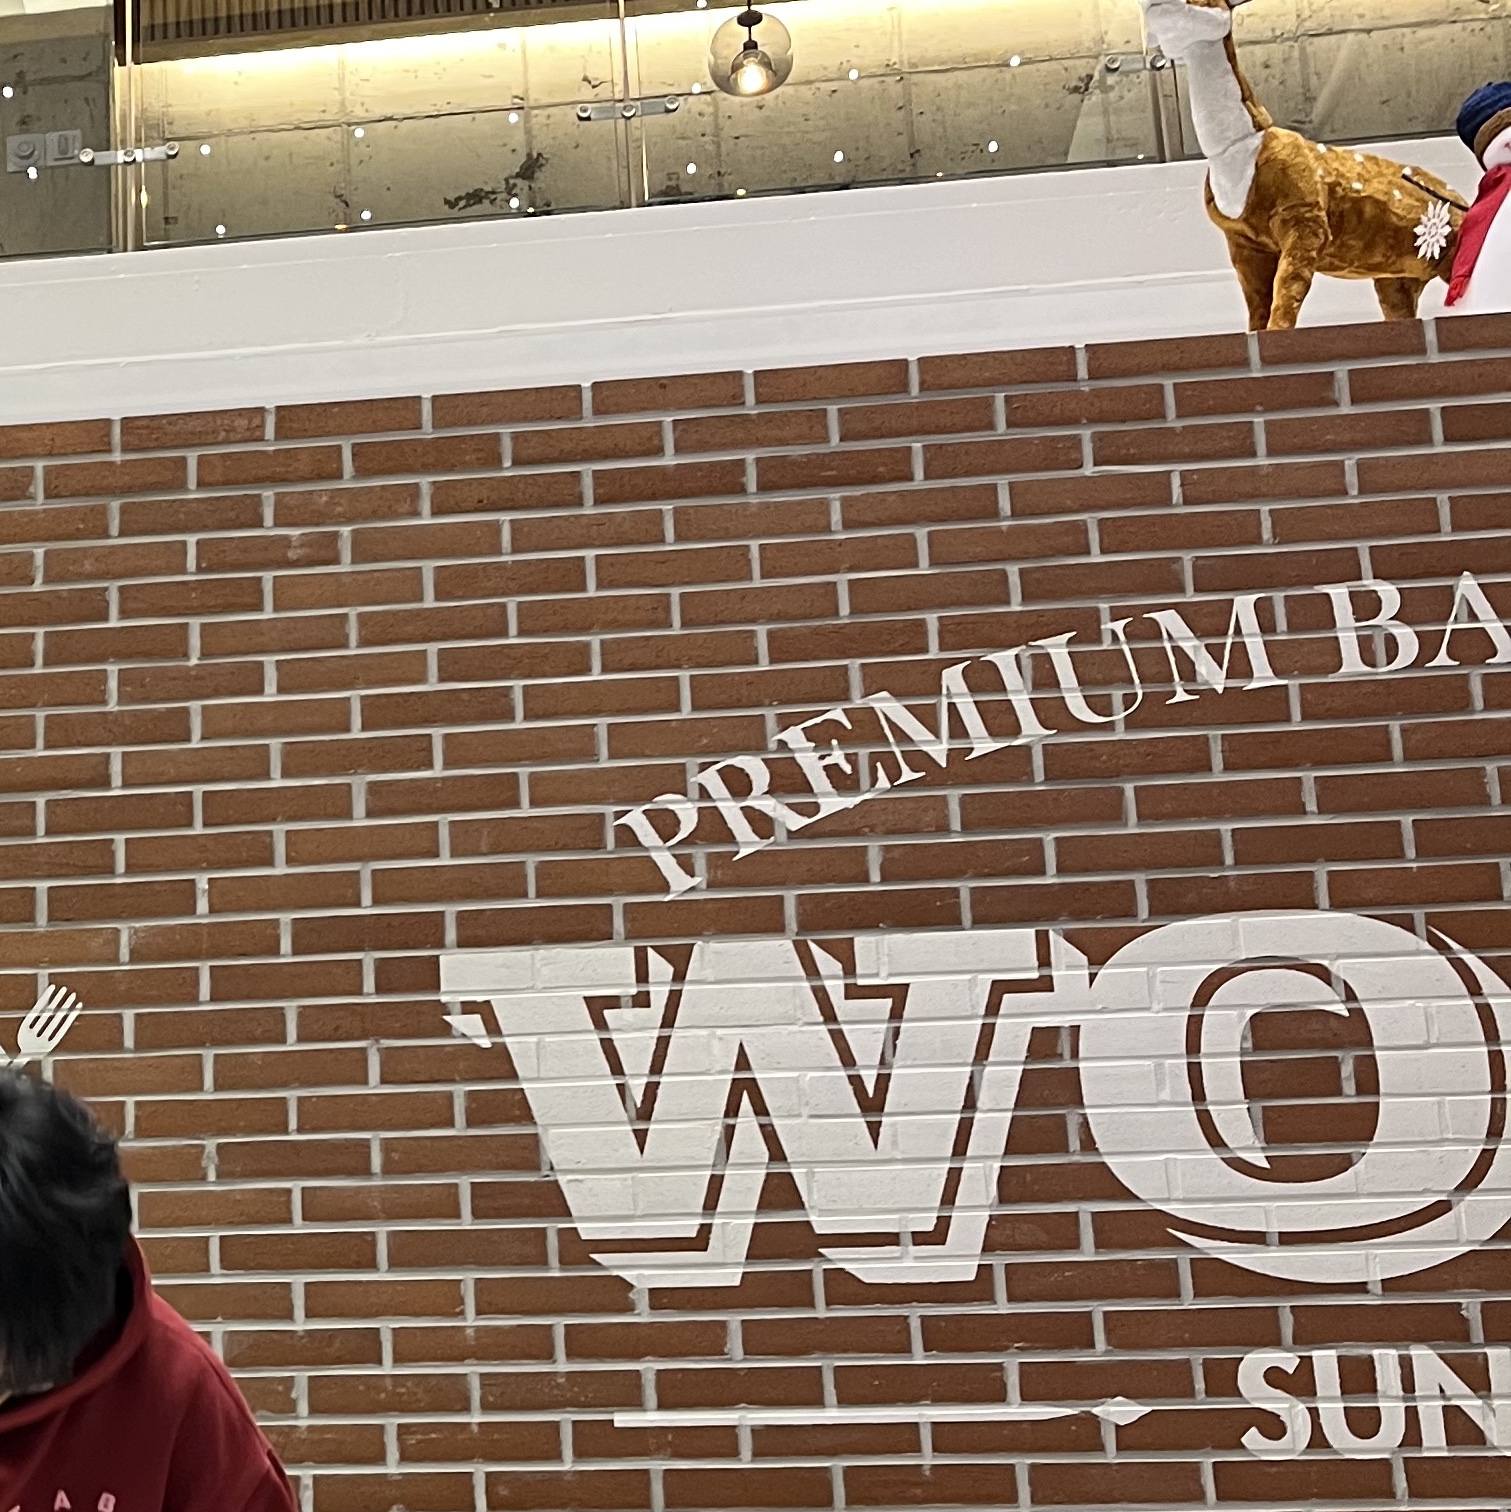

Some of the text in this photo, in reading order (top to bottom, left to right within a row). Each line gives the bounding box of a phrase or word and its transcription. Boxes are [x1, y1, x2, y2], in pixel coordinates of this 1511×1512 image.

[613, 570, 1511, 902] PREMIUM BA
[439, 909, 1511, 1287] WO
[1237, 1345, 1511, 1460] SUN
